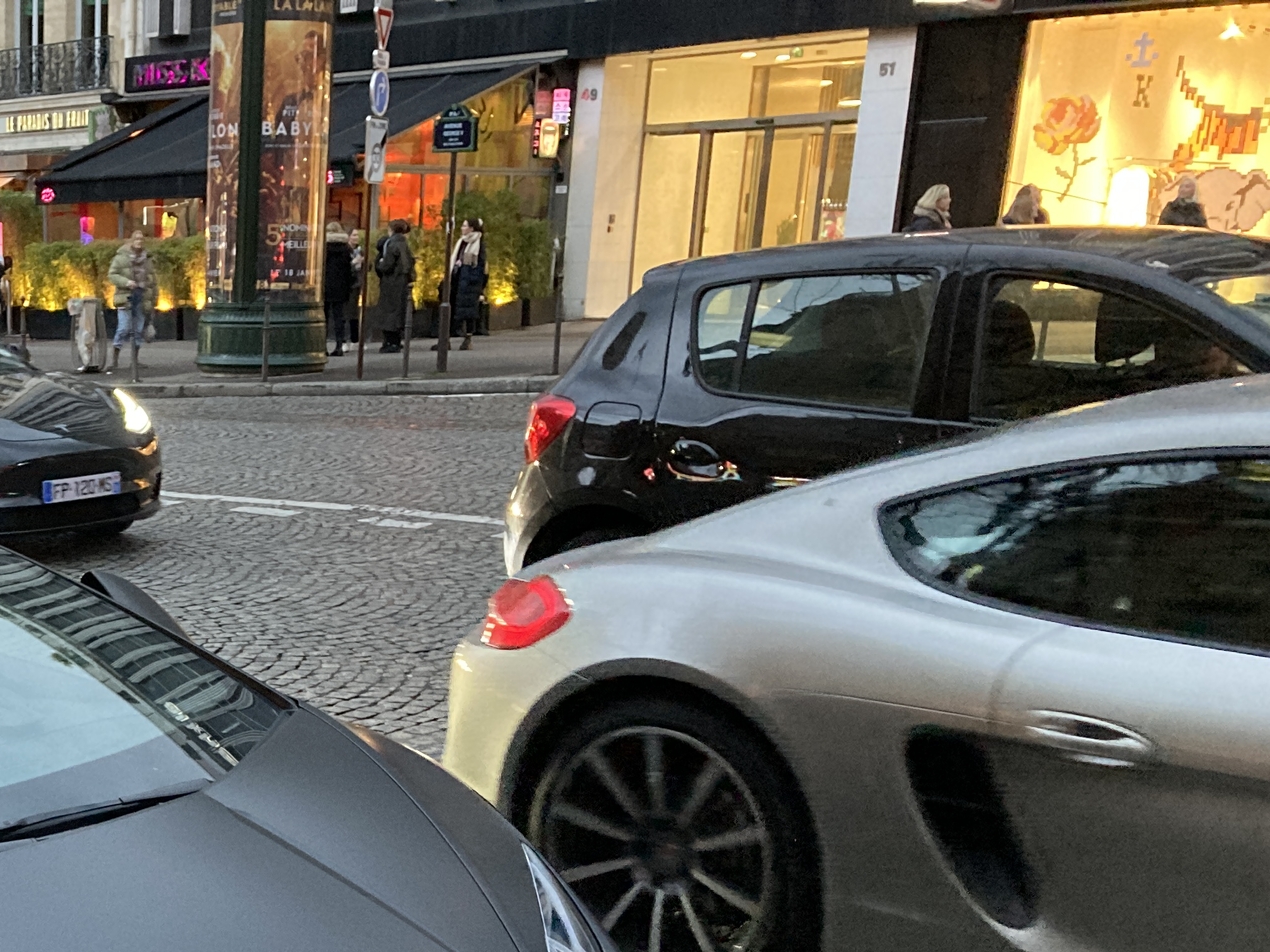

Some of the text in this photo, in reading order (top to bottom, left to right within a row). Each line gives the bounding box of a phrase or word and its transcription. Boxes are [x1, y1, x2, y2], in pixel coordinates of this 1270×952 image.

[879, 61, 896, 77] 51
[581, 88, 599, 101] 49
[5, 109, 90, 133] LE PARADIS DU FRUIT
[261, 120, 312, 136] BABY
[265, 223, 282, 247] 5
